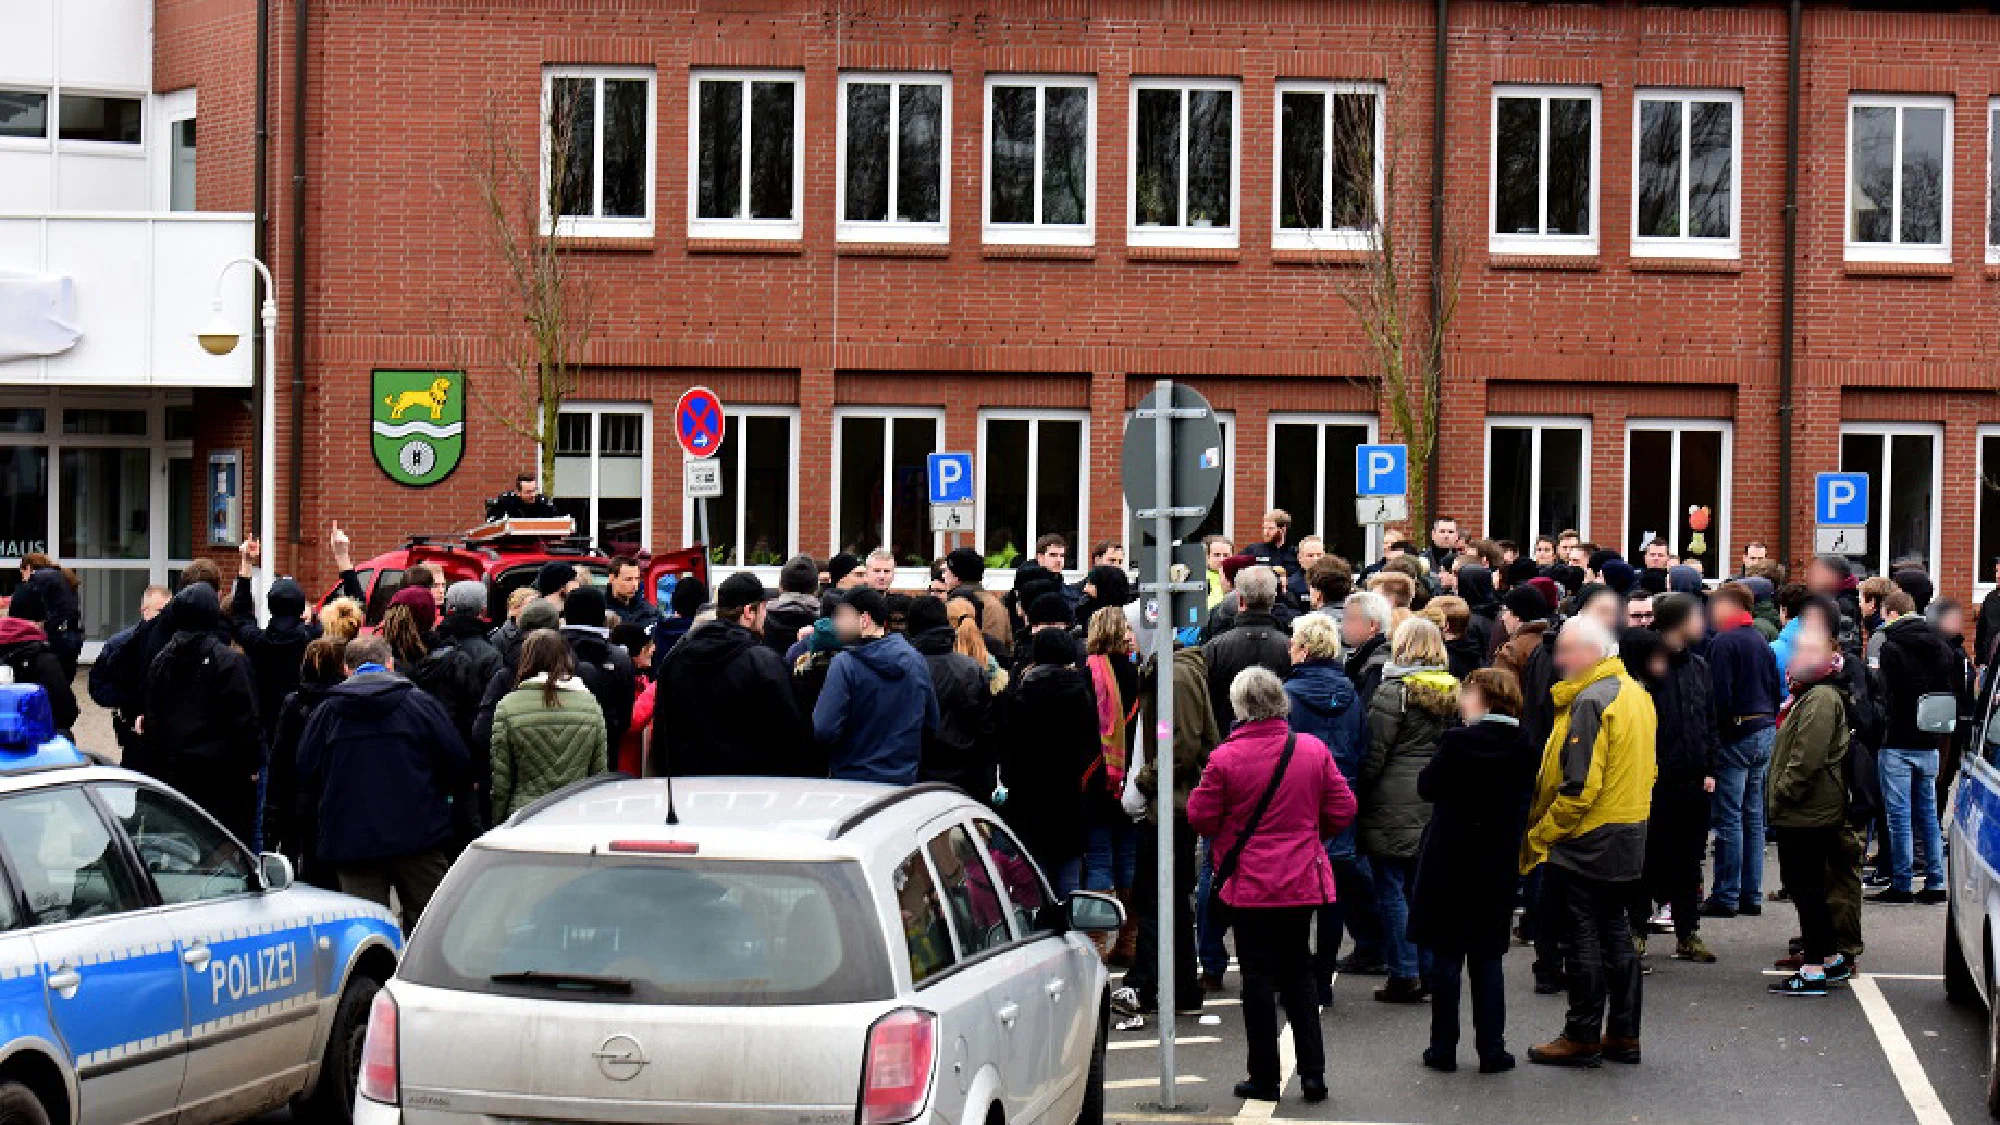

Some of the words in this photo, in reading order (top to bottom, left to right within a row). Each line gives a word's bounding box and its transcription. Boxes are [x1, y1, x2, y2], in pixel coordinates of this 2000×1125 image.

[938, 459, 962, 496] P
[1369, 450, 1395, 490] P
[1828, 480, 1856, 518] P
[211, 942, 296, 1005] POLIZEI
